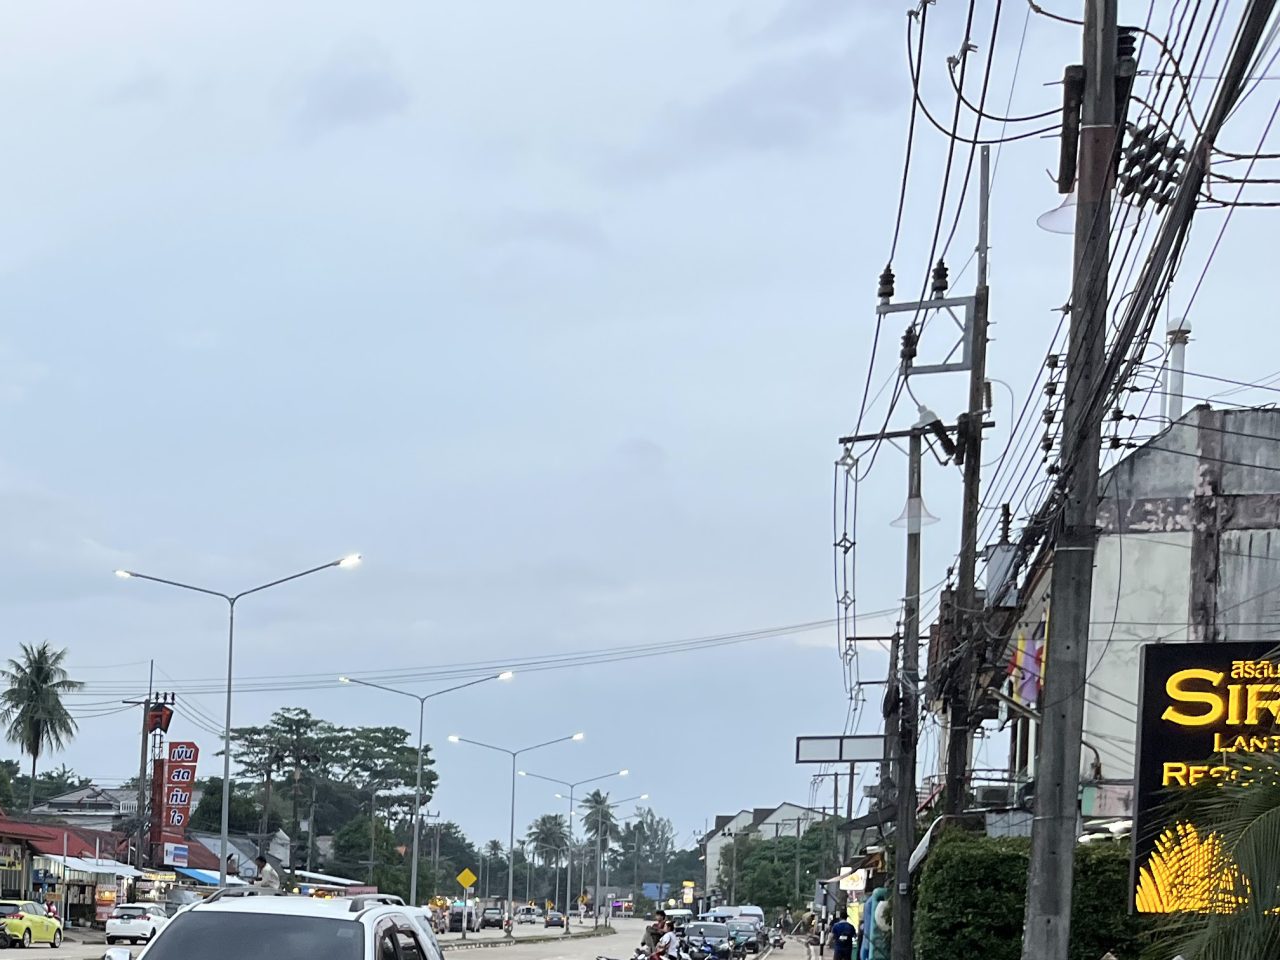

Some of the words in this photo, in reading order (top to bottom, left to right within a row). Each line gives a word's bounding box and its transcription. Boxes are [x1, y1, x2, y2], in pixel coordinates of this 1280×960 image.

[172, 745, 193, 760] เงิน
[172, 769, 191, 781] สด
[170, 788, 189, 805] ทัน
[170, 809, 184, 826] ใจ
